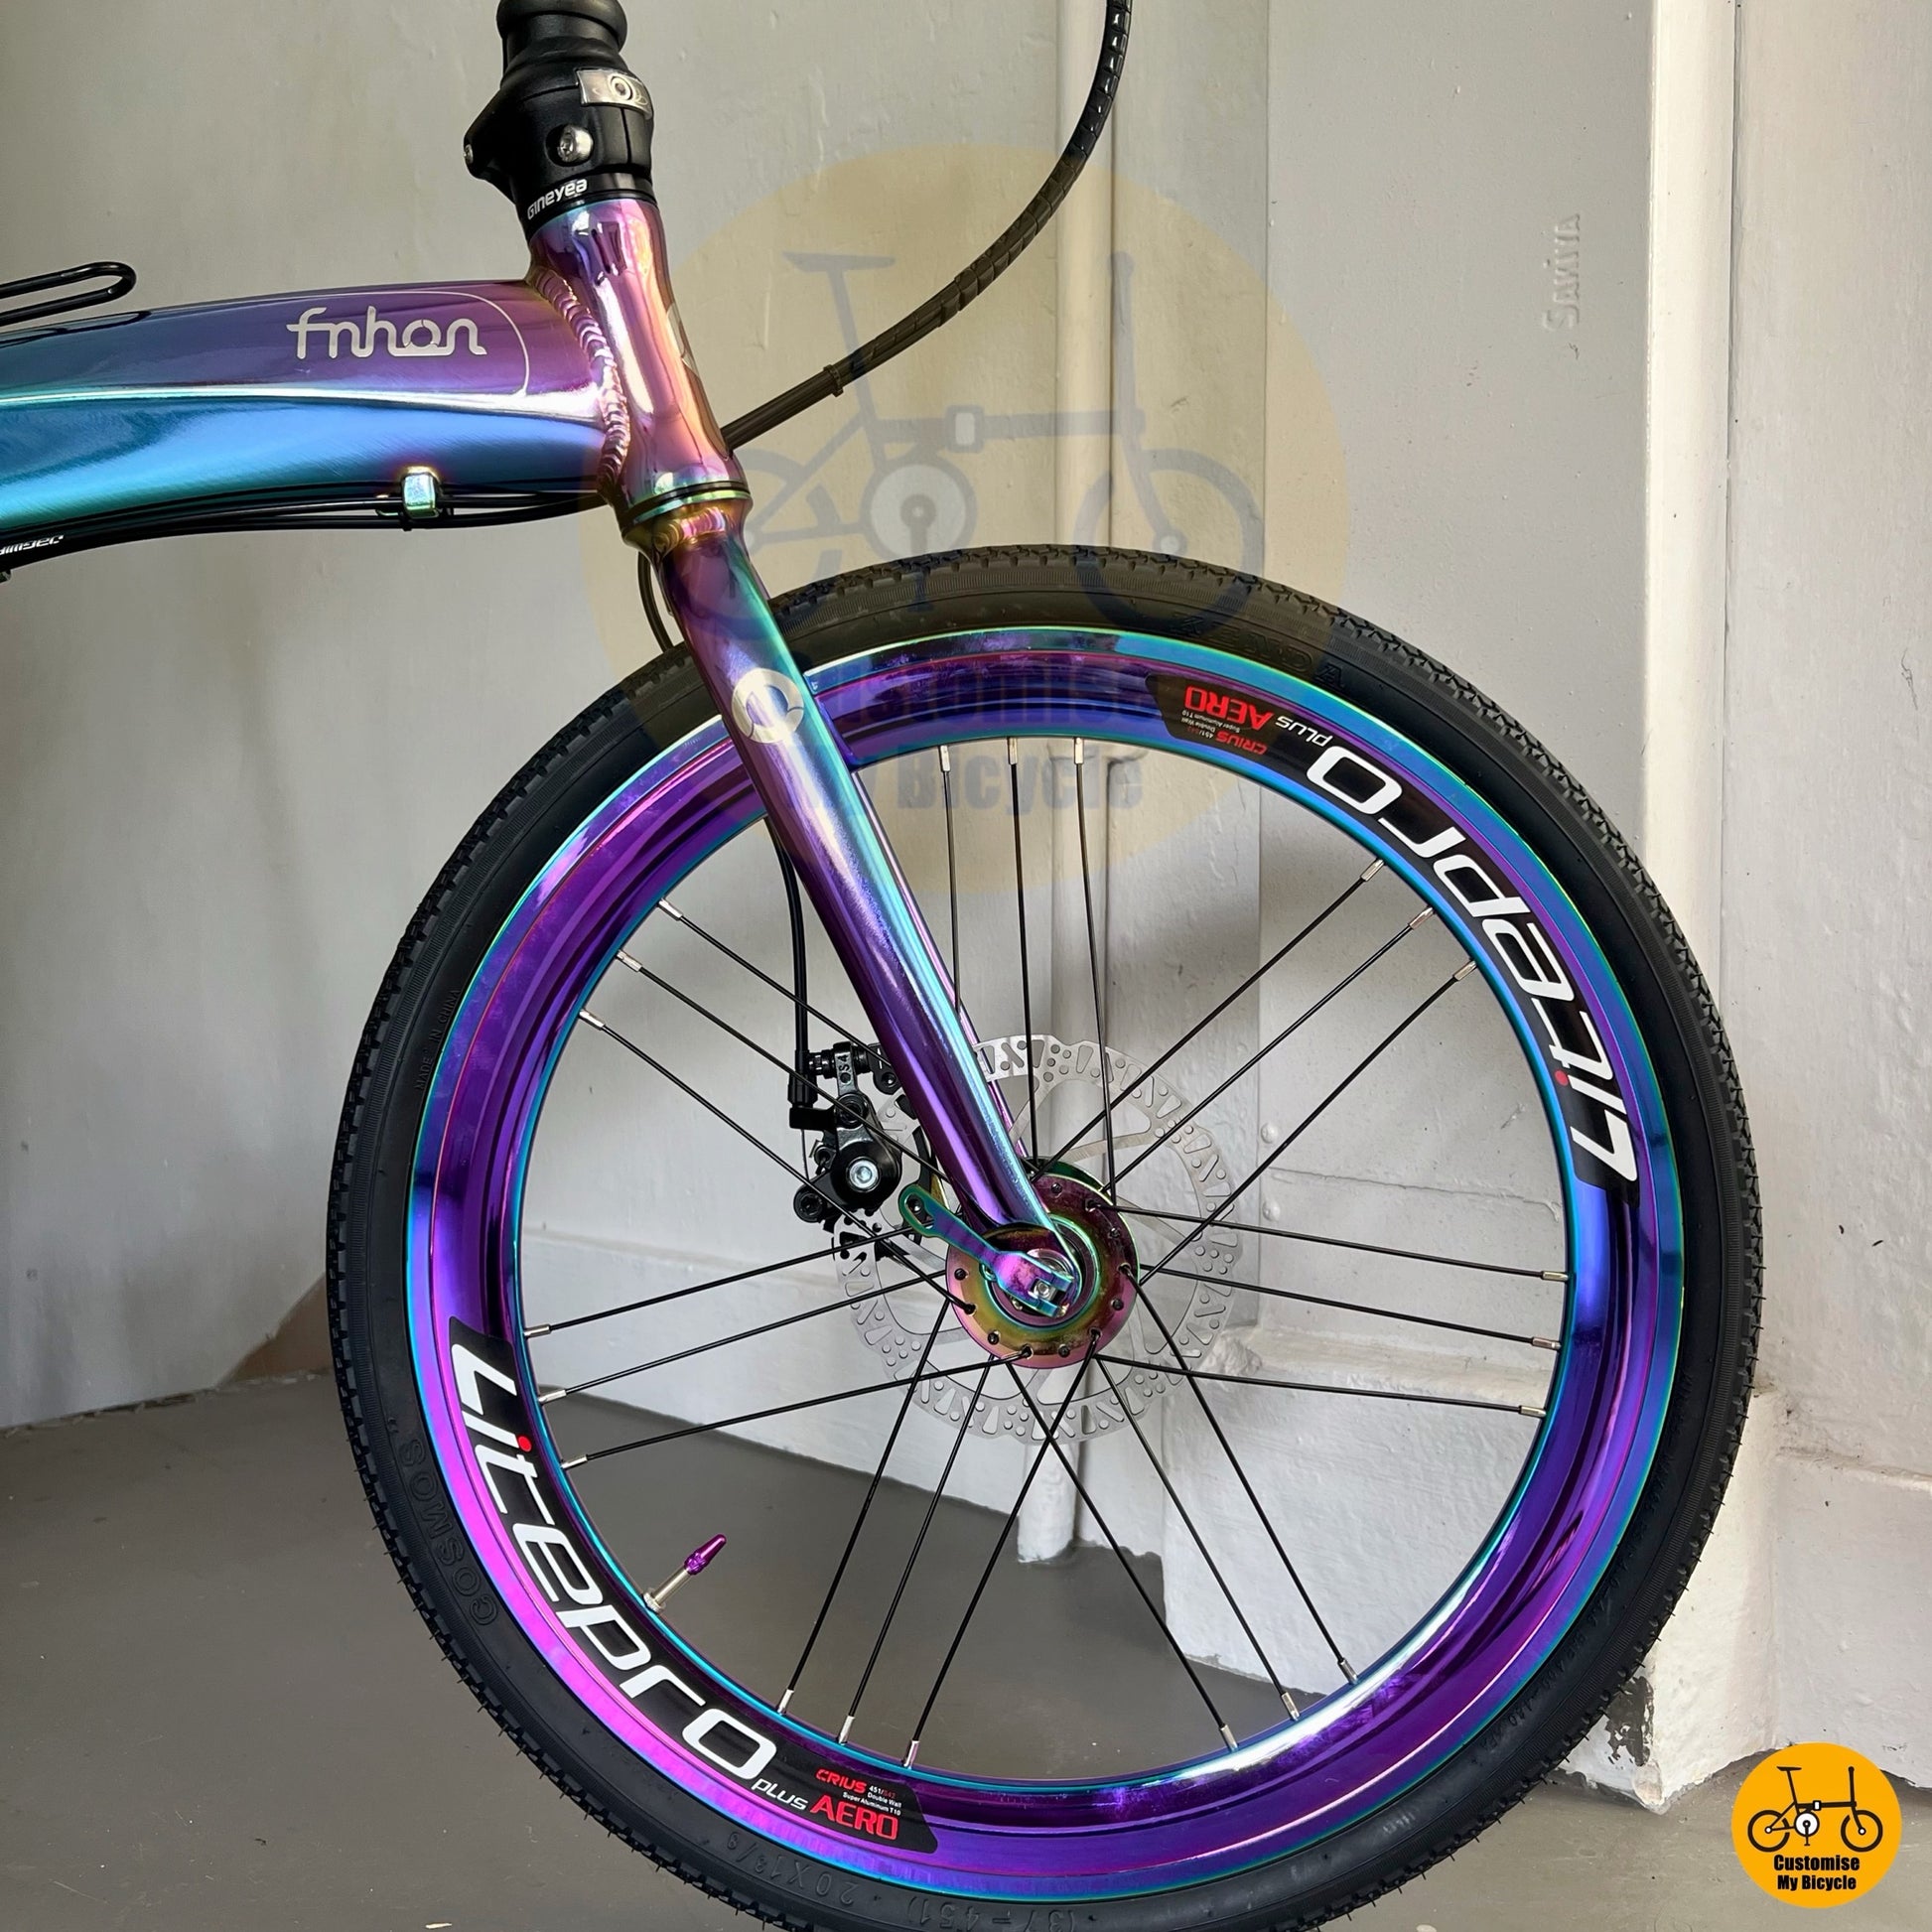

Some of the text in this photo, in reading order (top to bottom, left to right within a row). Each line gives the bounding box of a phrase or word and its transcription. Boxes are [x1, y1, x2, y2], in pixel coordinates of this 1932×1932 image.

[286, 305, 488, 359] fnhon
[1184, 685, 1275, 731] AERO
[1215, 731, 1269, 756] CRIUS
[399, 1439, 498, 1626] COSMOS
[815, 1768, 869, 1794] CRIUS
[810, 1794, 900, 1841] AERO
